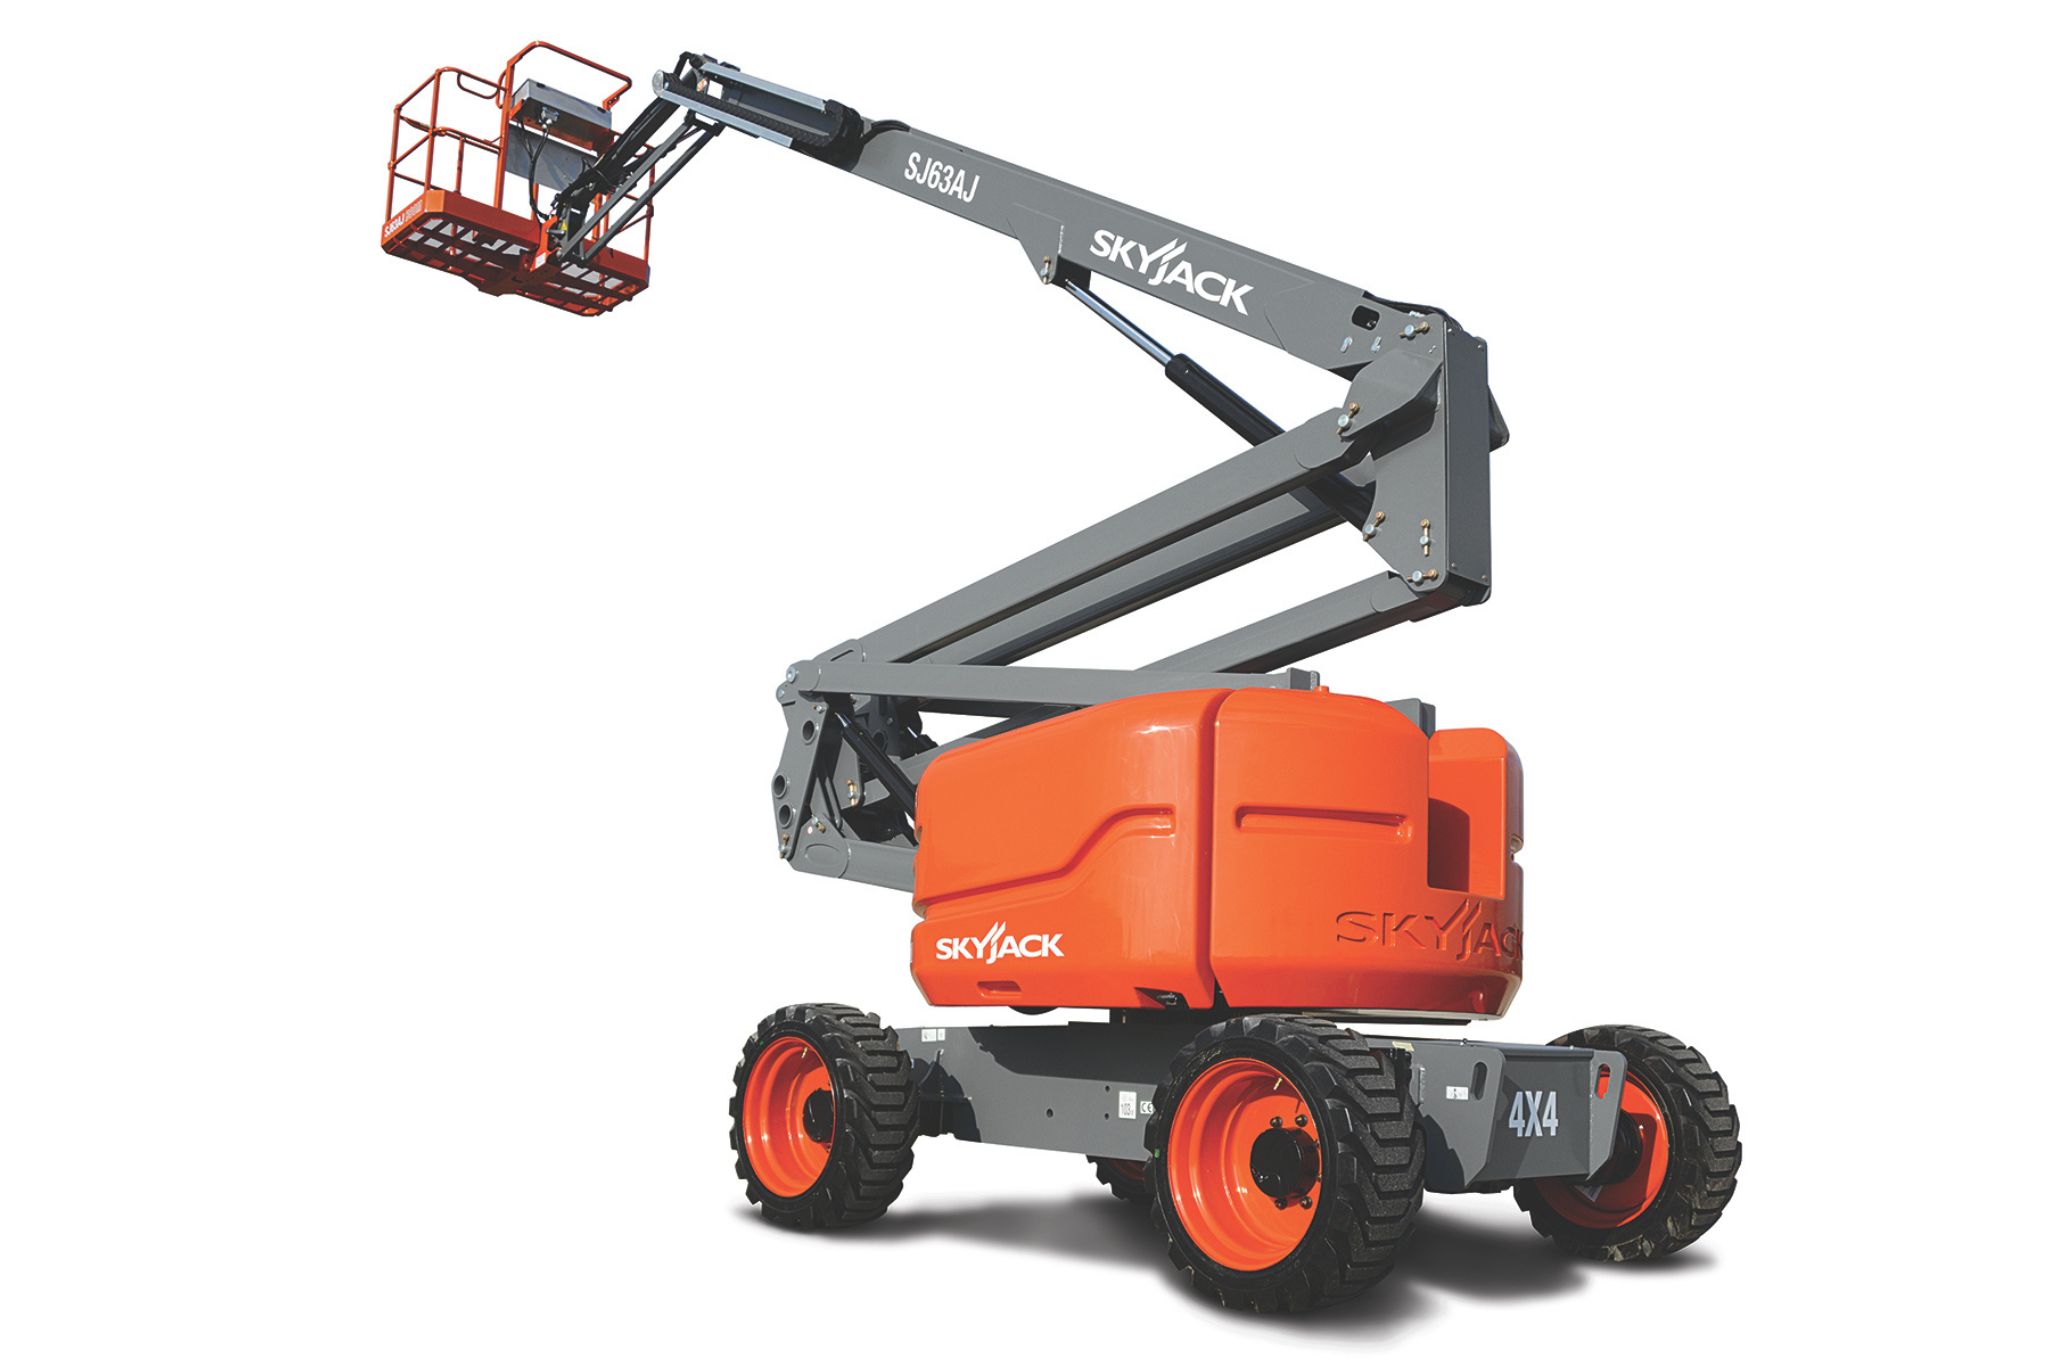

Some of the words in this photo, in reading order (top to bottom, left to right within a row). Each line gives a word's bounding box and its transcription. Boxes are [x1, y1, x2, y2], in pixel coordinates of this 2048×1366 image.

[904, 152, 979, 202] SJ63AJ
[1090, 229, 1254, 315] SKYJACK
[935, 921, 1064, 964] SKYJACK
[1508, 1090, 1559, 1137] 4X4
